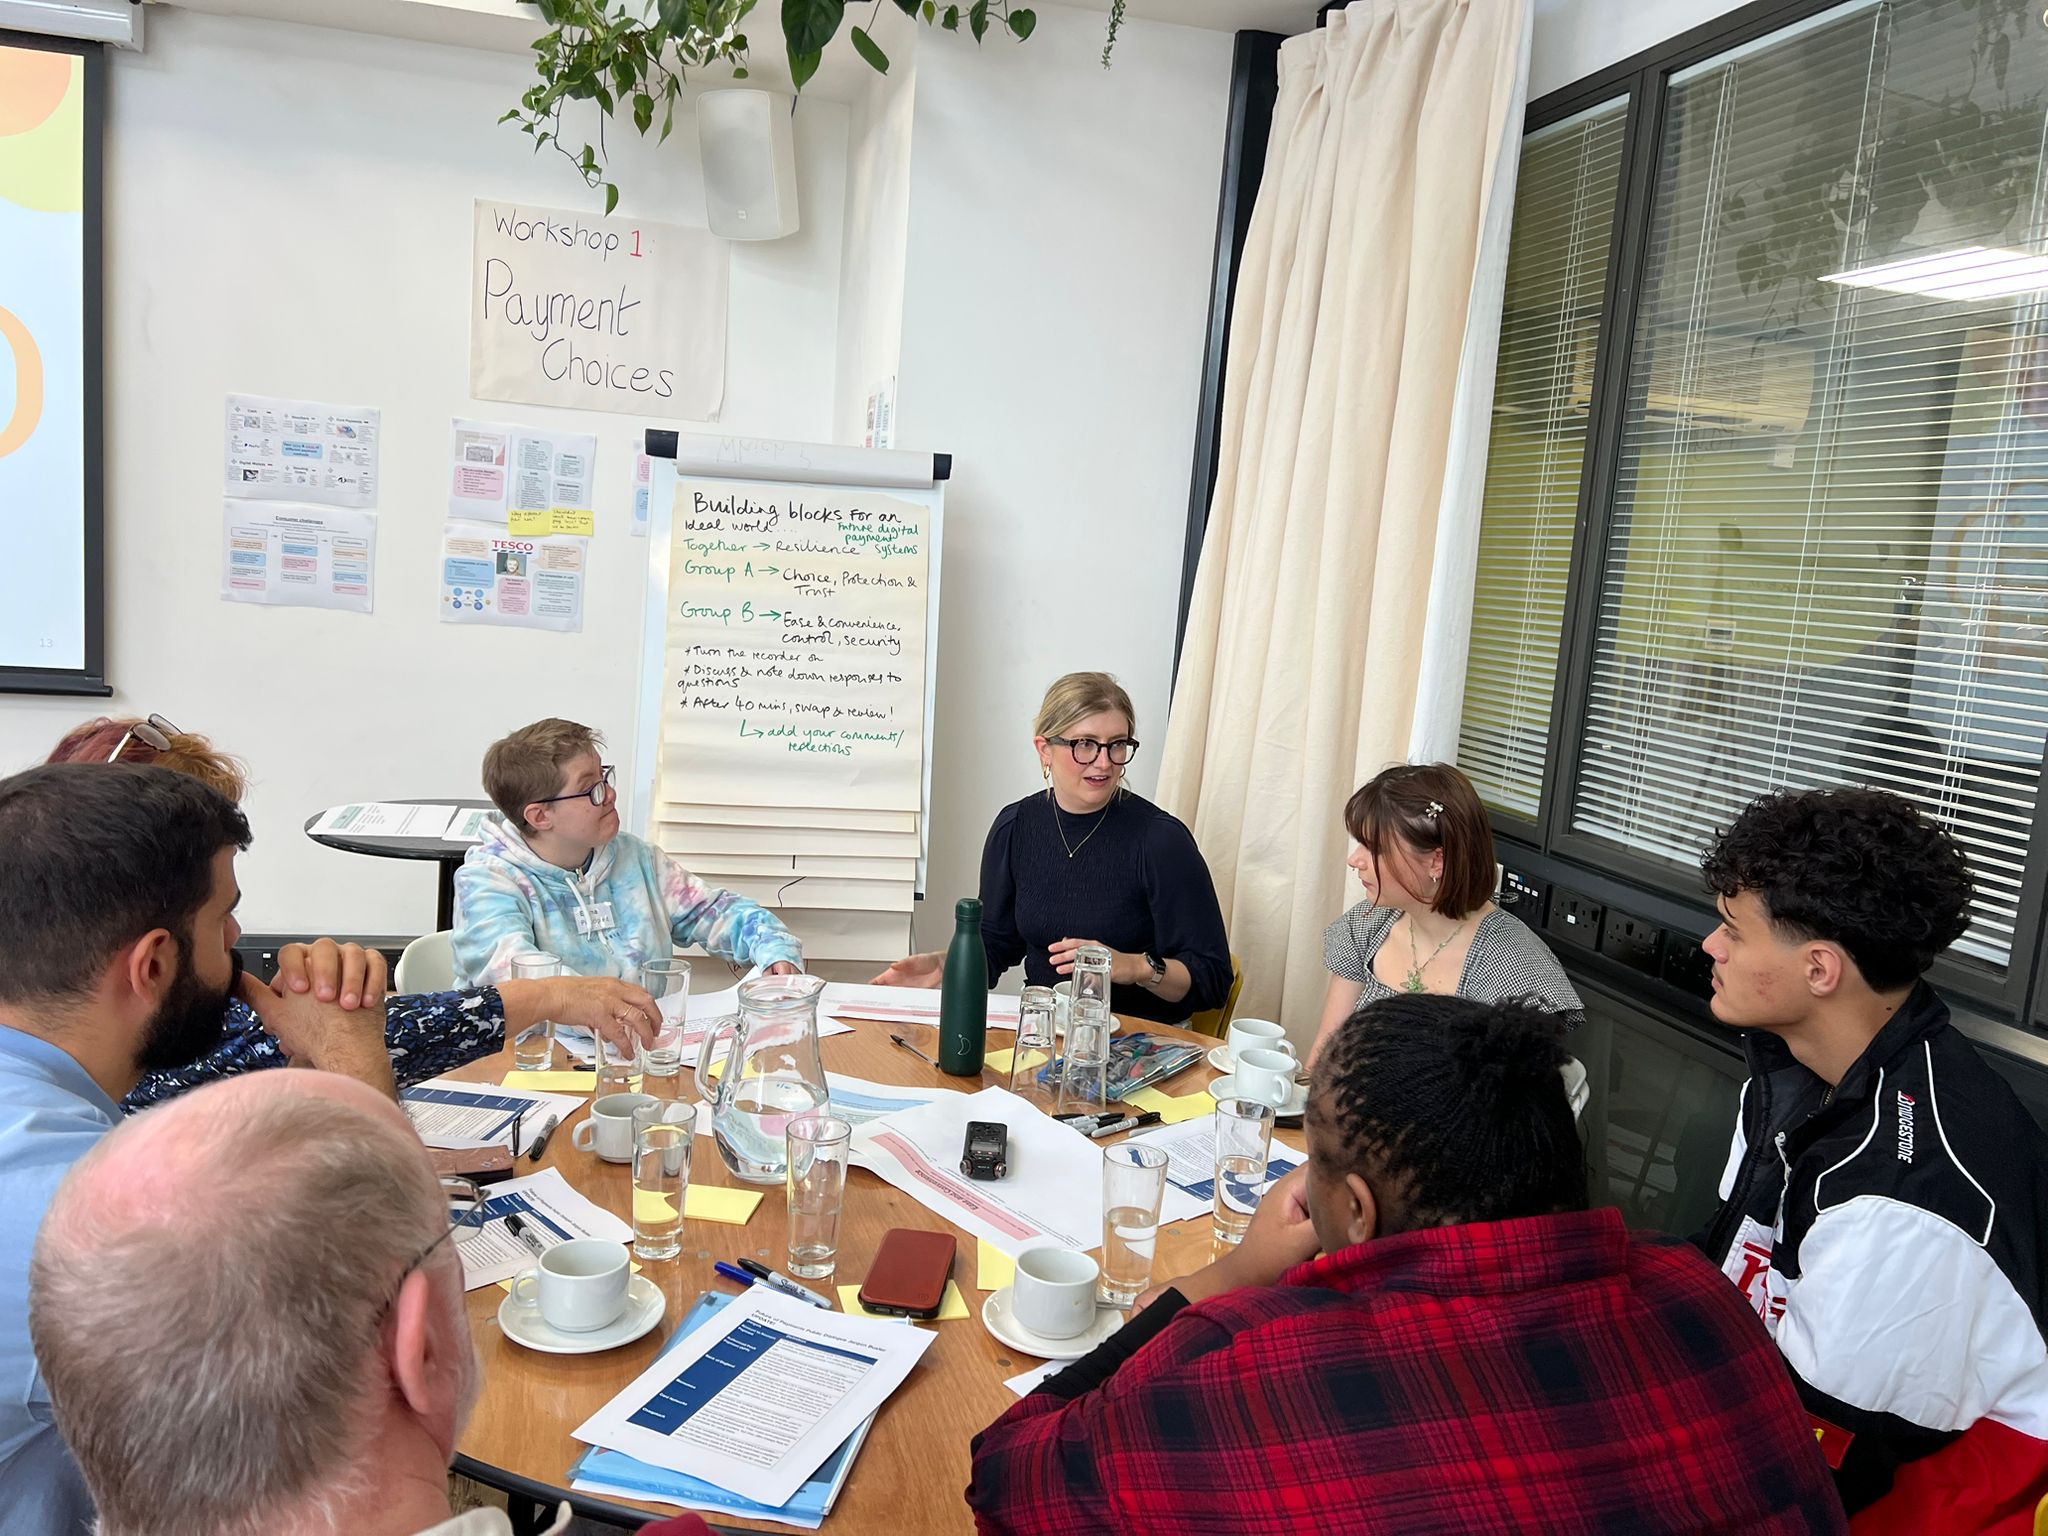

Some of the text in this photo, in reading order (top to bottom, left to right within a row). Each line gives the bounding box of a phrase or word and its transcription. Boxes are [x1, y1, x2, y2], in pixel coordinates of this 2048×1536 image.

[493, 208, 619, 262] Workshop
[485, 258, 641, 341] Payment
[542, 338, 674, 398] Choices
[694, 492, 779, 527] Building
[789, 501, 843, 522] blocks
[878, 513, 901, 524] an
[845, 532, 896, 546] payment
[878, 523, 919, 538] digital
[492, 540, 534, 551] TESCO
[683, 537, 861, 559] Together Resilience
[684, 560, 754, 583] Group A
[794, 585, 836, 598] Trust
[907, 576, 918, 588] &
[680, 601, 754, 626] Group B
[783, 612, 814, 629] Ease
[39, 638, 54, 648] 13
[844, 636, 901, 656] security
[728, 647, 746, 659] the
[752, 648, 801, 662] recorder
[808, 654, 824, 663] on
[677, 678, 741, 695] questions
[694, 665, 737, 678] Discuss
[756, 667, 783, 679] note
[787, 667, 826, 683] down
[829, 671, 883, 688] responses
[887, 672, 902, 683] to
[693, 698, 730, 710] After
[735, 695, 755, 711] 40
[795, 702, 831, 719] swap
[767, 725, 798, 738] add
[803, 728, 836, 746] your
[788, 739, 854, 757] reflections
